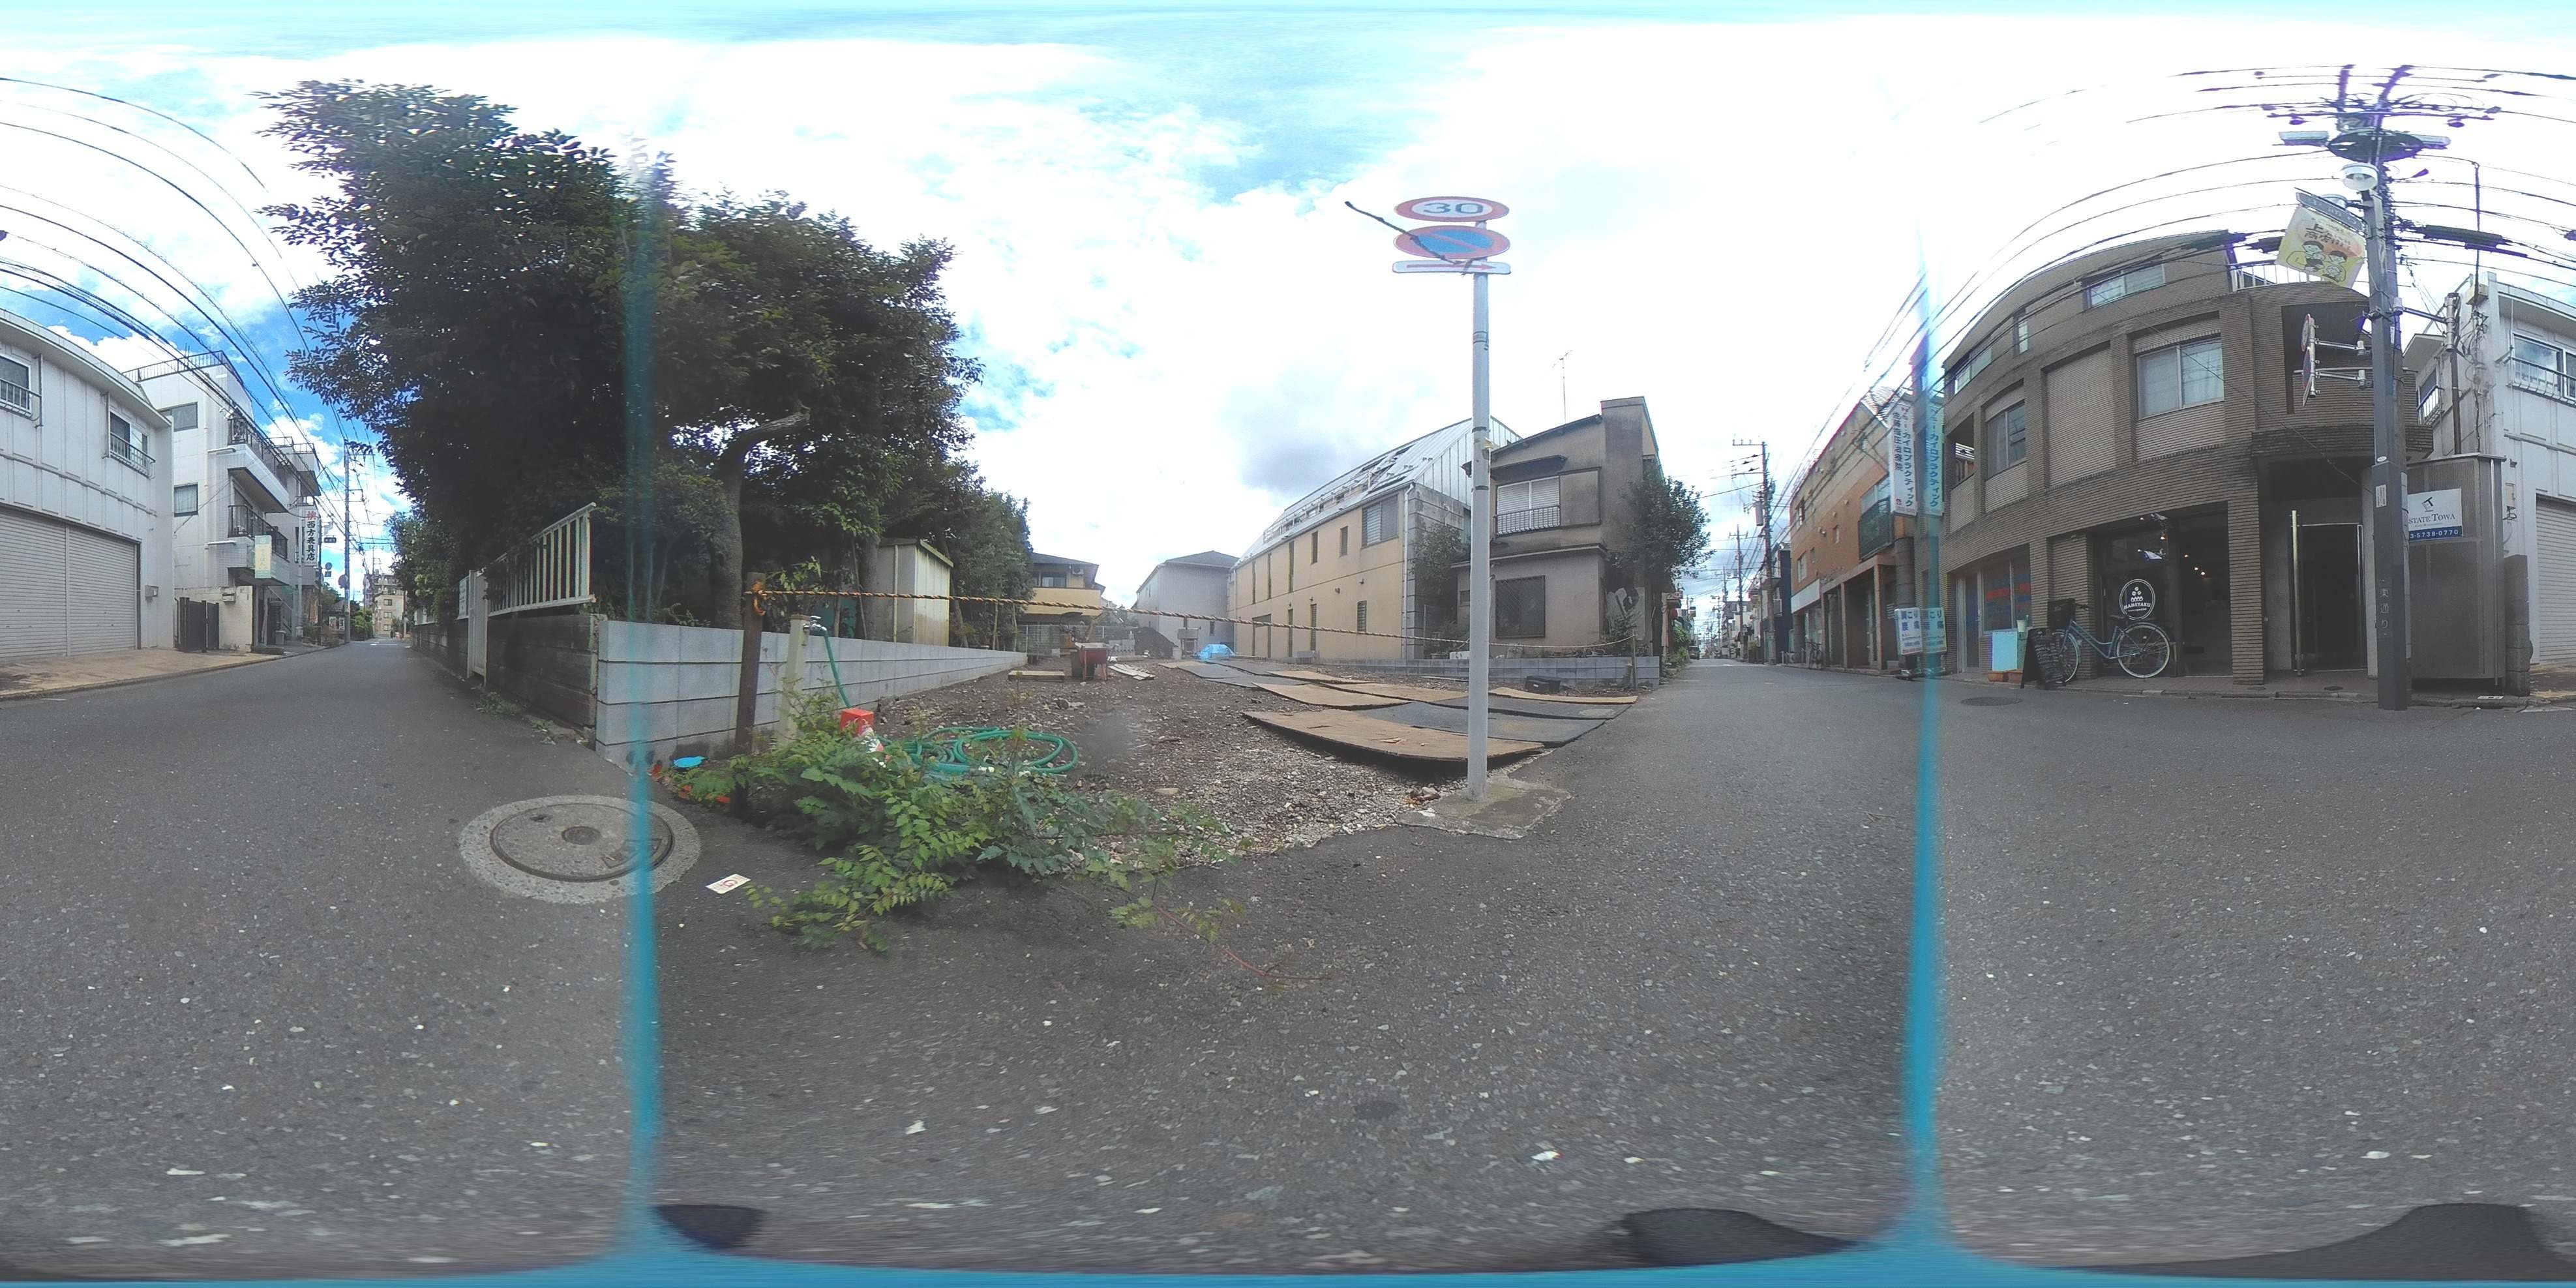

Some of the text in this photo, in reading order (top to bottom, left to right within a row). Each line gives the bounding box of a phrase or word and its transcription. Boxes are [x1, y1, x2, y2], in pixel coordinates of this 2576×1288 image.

[1423, 202, 1484, 215] 30
[2431, 513, 2456, 522] TOWA
[2410, 529, 2459, 539] 3-5738-0770
